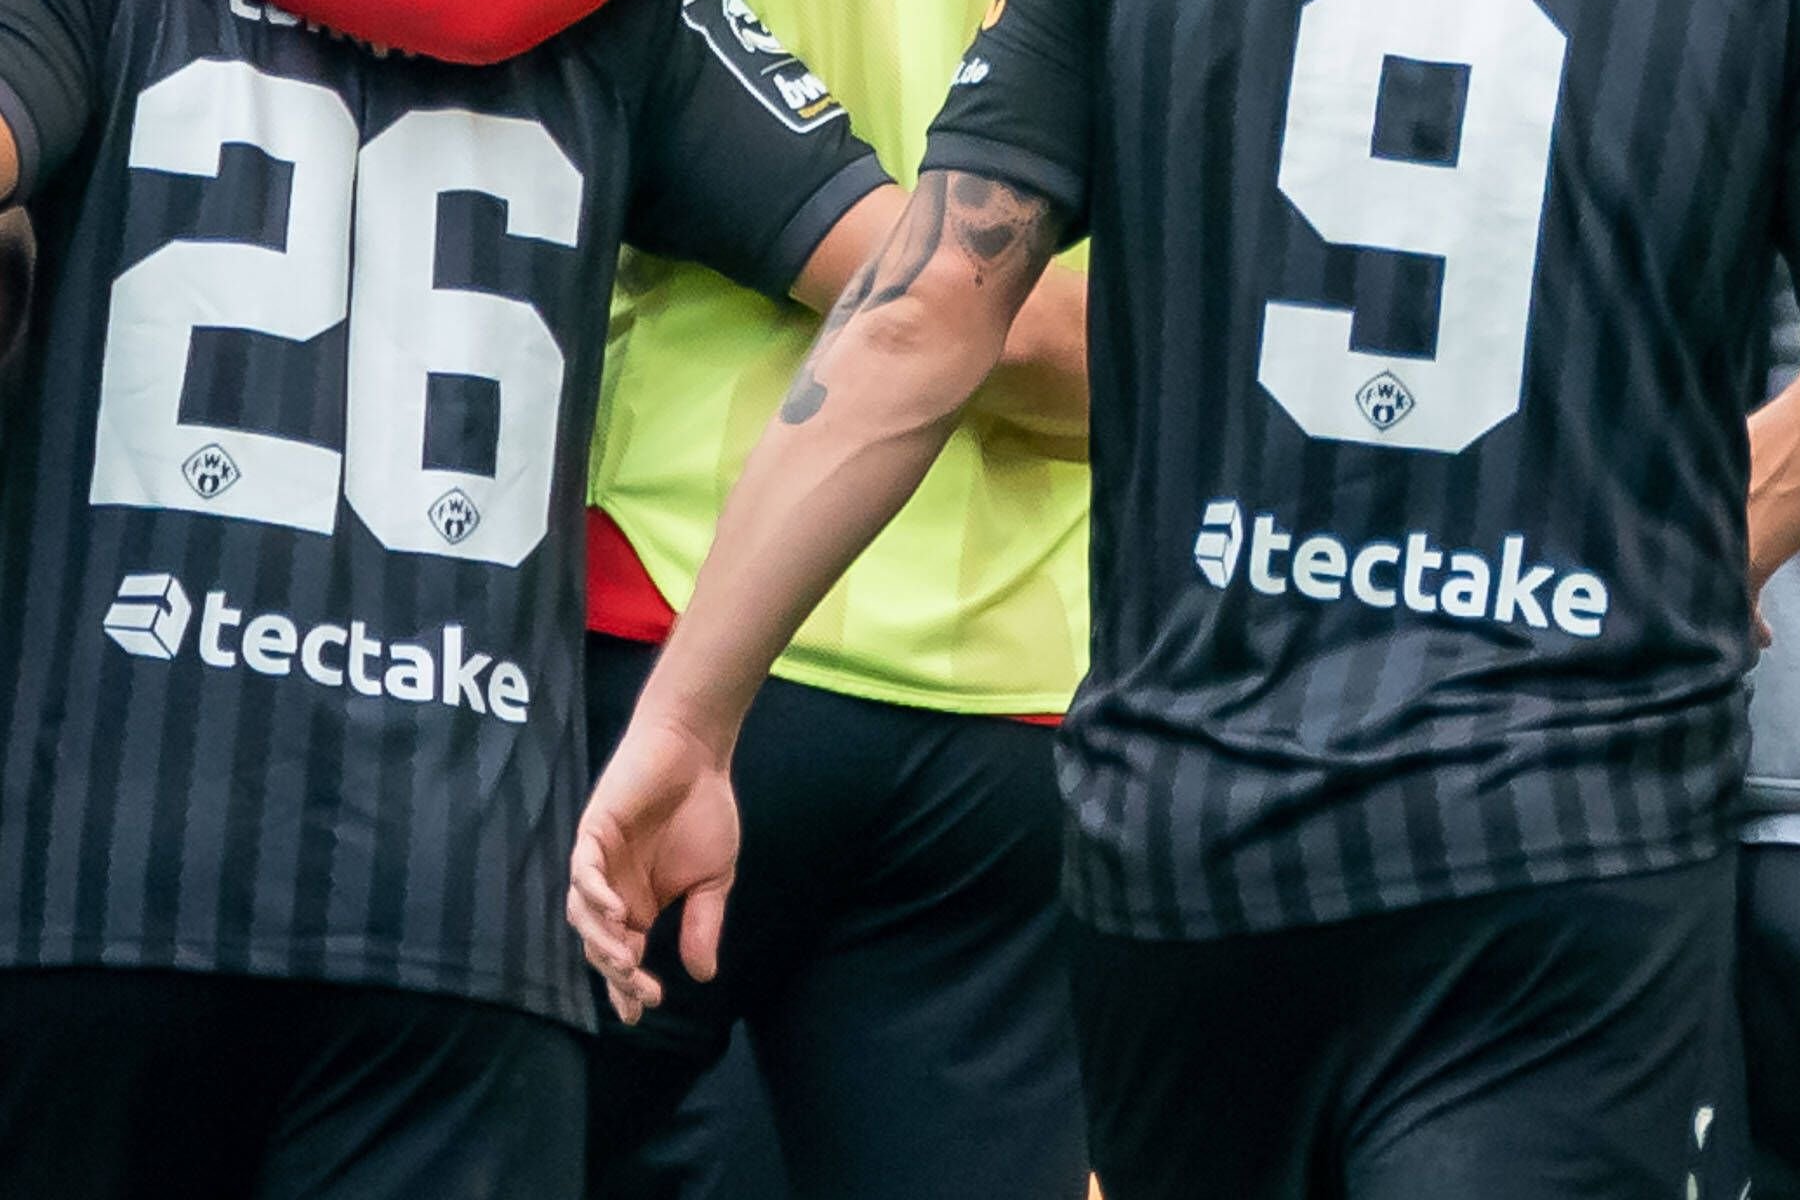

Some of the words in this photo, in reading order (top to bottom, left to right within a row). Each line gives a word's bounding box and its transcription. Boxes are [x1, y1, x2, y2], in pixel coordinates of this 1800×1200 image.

[89, 58, 584, 568] 26
[1248, 516, 1609, 637] tectake
[199, 590, 530, 723] tectake
